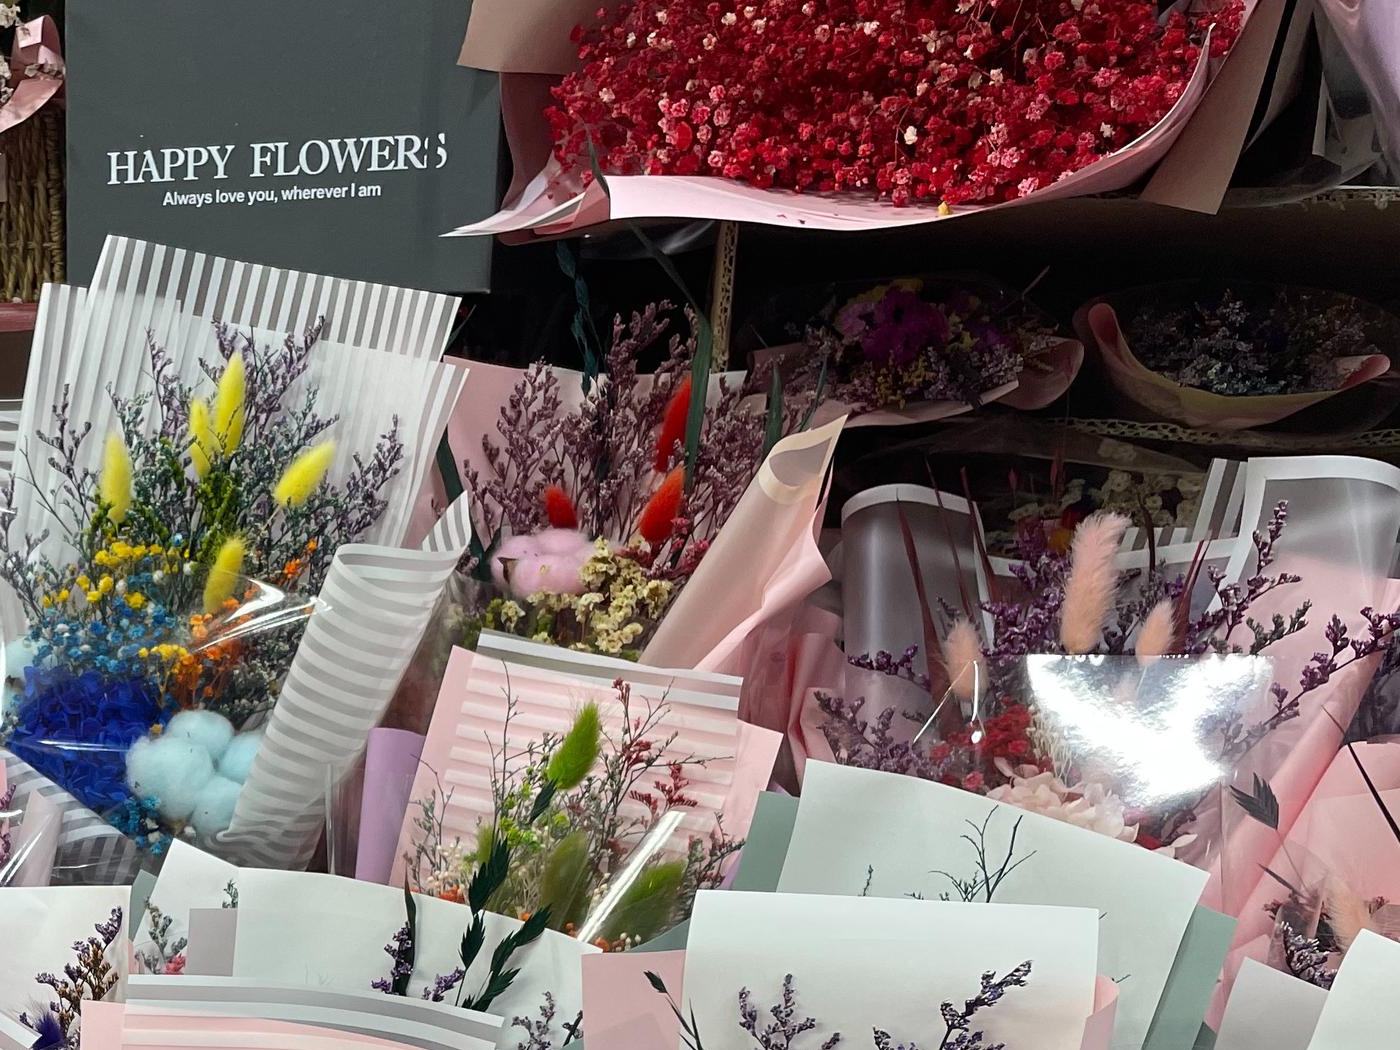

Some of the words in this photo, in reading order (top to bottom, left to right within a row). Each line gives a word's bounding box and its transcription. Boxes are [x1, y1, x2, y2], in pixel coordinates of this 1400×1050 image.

[106, 145, 235, 185] HAPPY
[250, 132, 448, 177] FLOWERS
[162, 191, 213, 208] Always
[215, 189, 245, 203] love
[247, 189, 279, 206] you,
[280, 185, 349, 201] wherever
[350, 182, 356, 198] I
[358, 184, 382, 198] am
